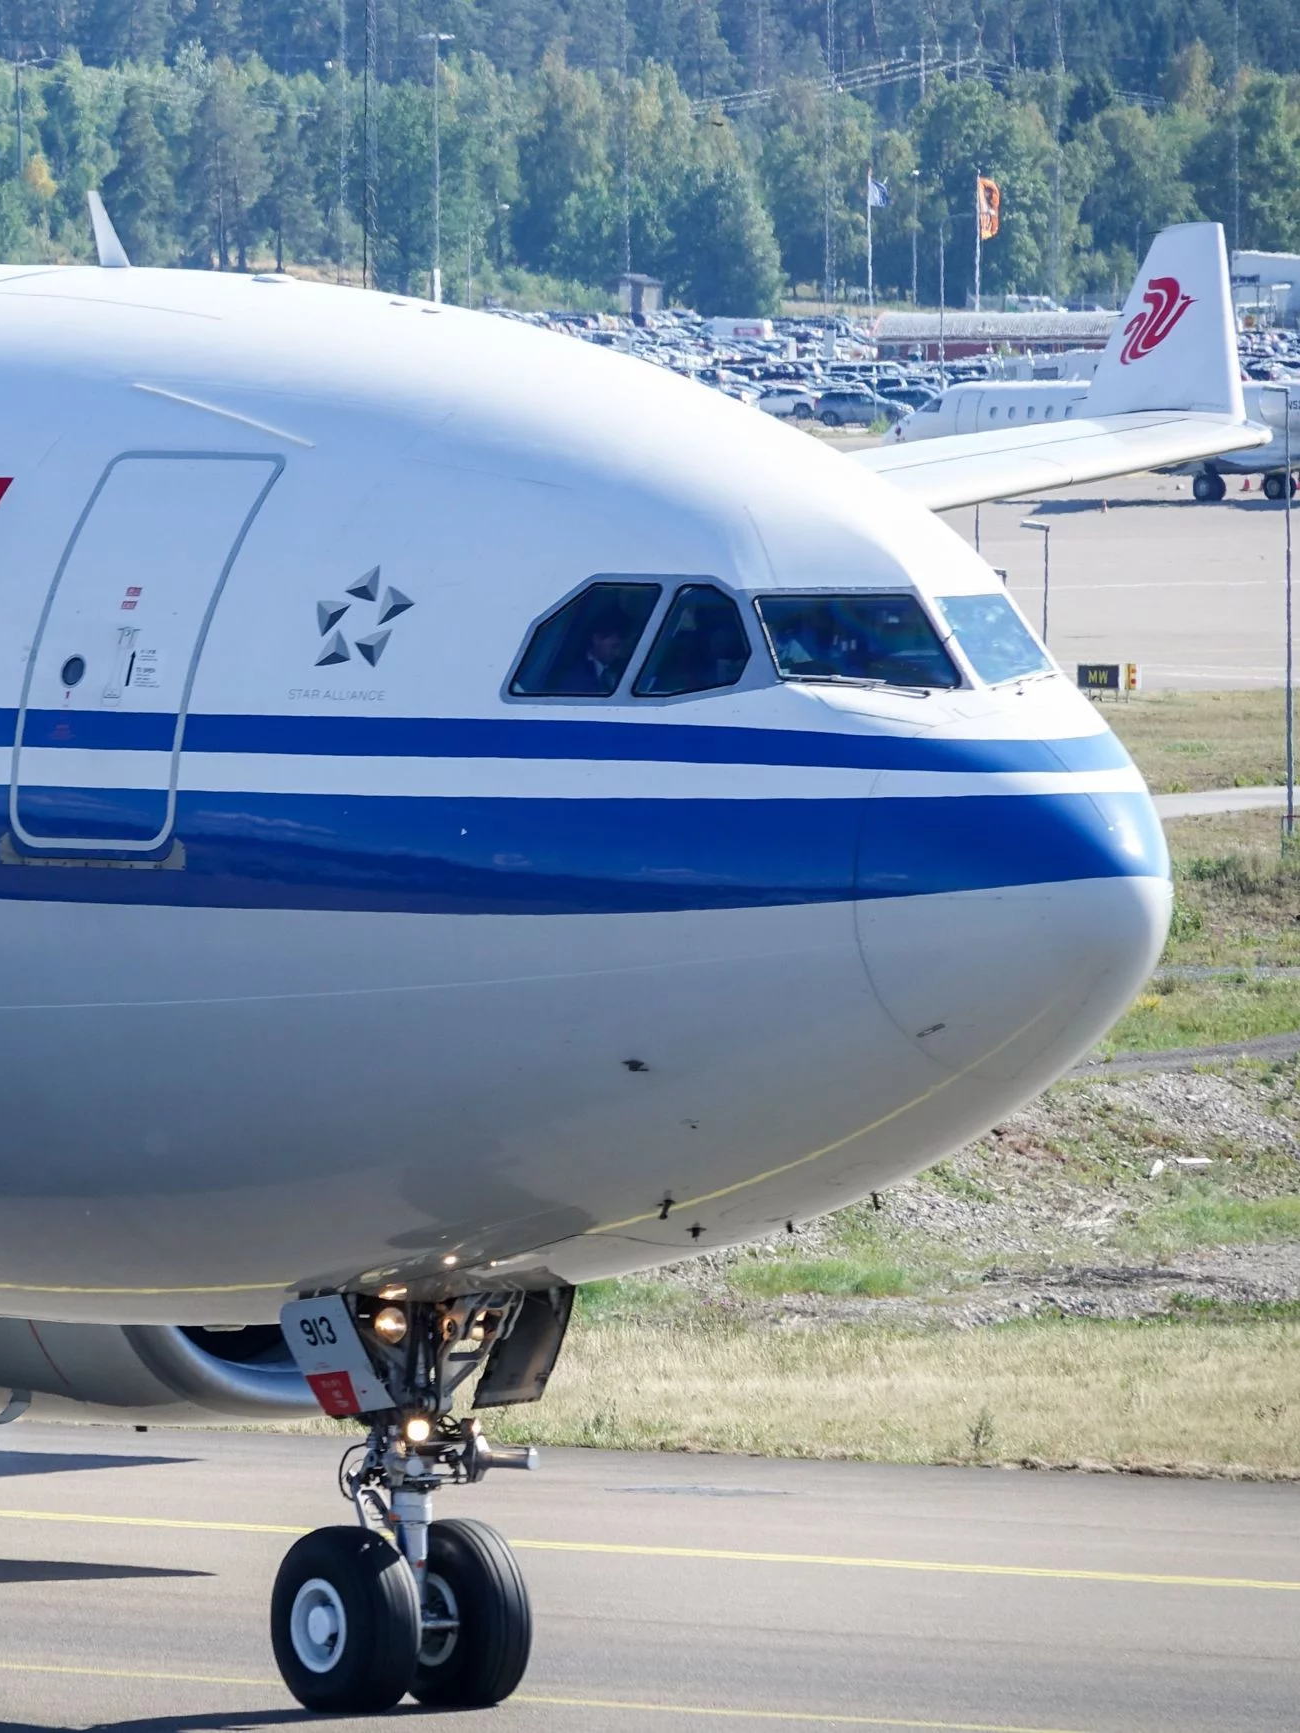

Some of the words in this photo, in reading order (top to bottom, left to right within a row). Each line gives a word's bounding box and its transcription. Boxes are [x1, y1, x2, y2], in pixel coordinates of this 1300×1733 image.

[1088, 669, 1109, 684] MW
[288, 688, 320, 701] STAR
[323, 689, 386, 701] ALLIANCE
[299, 1316, 337, 1346] 913
